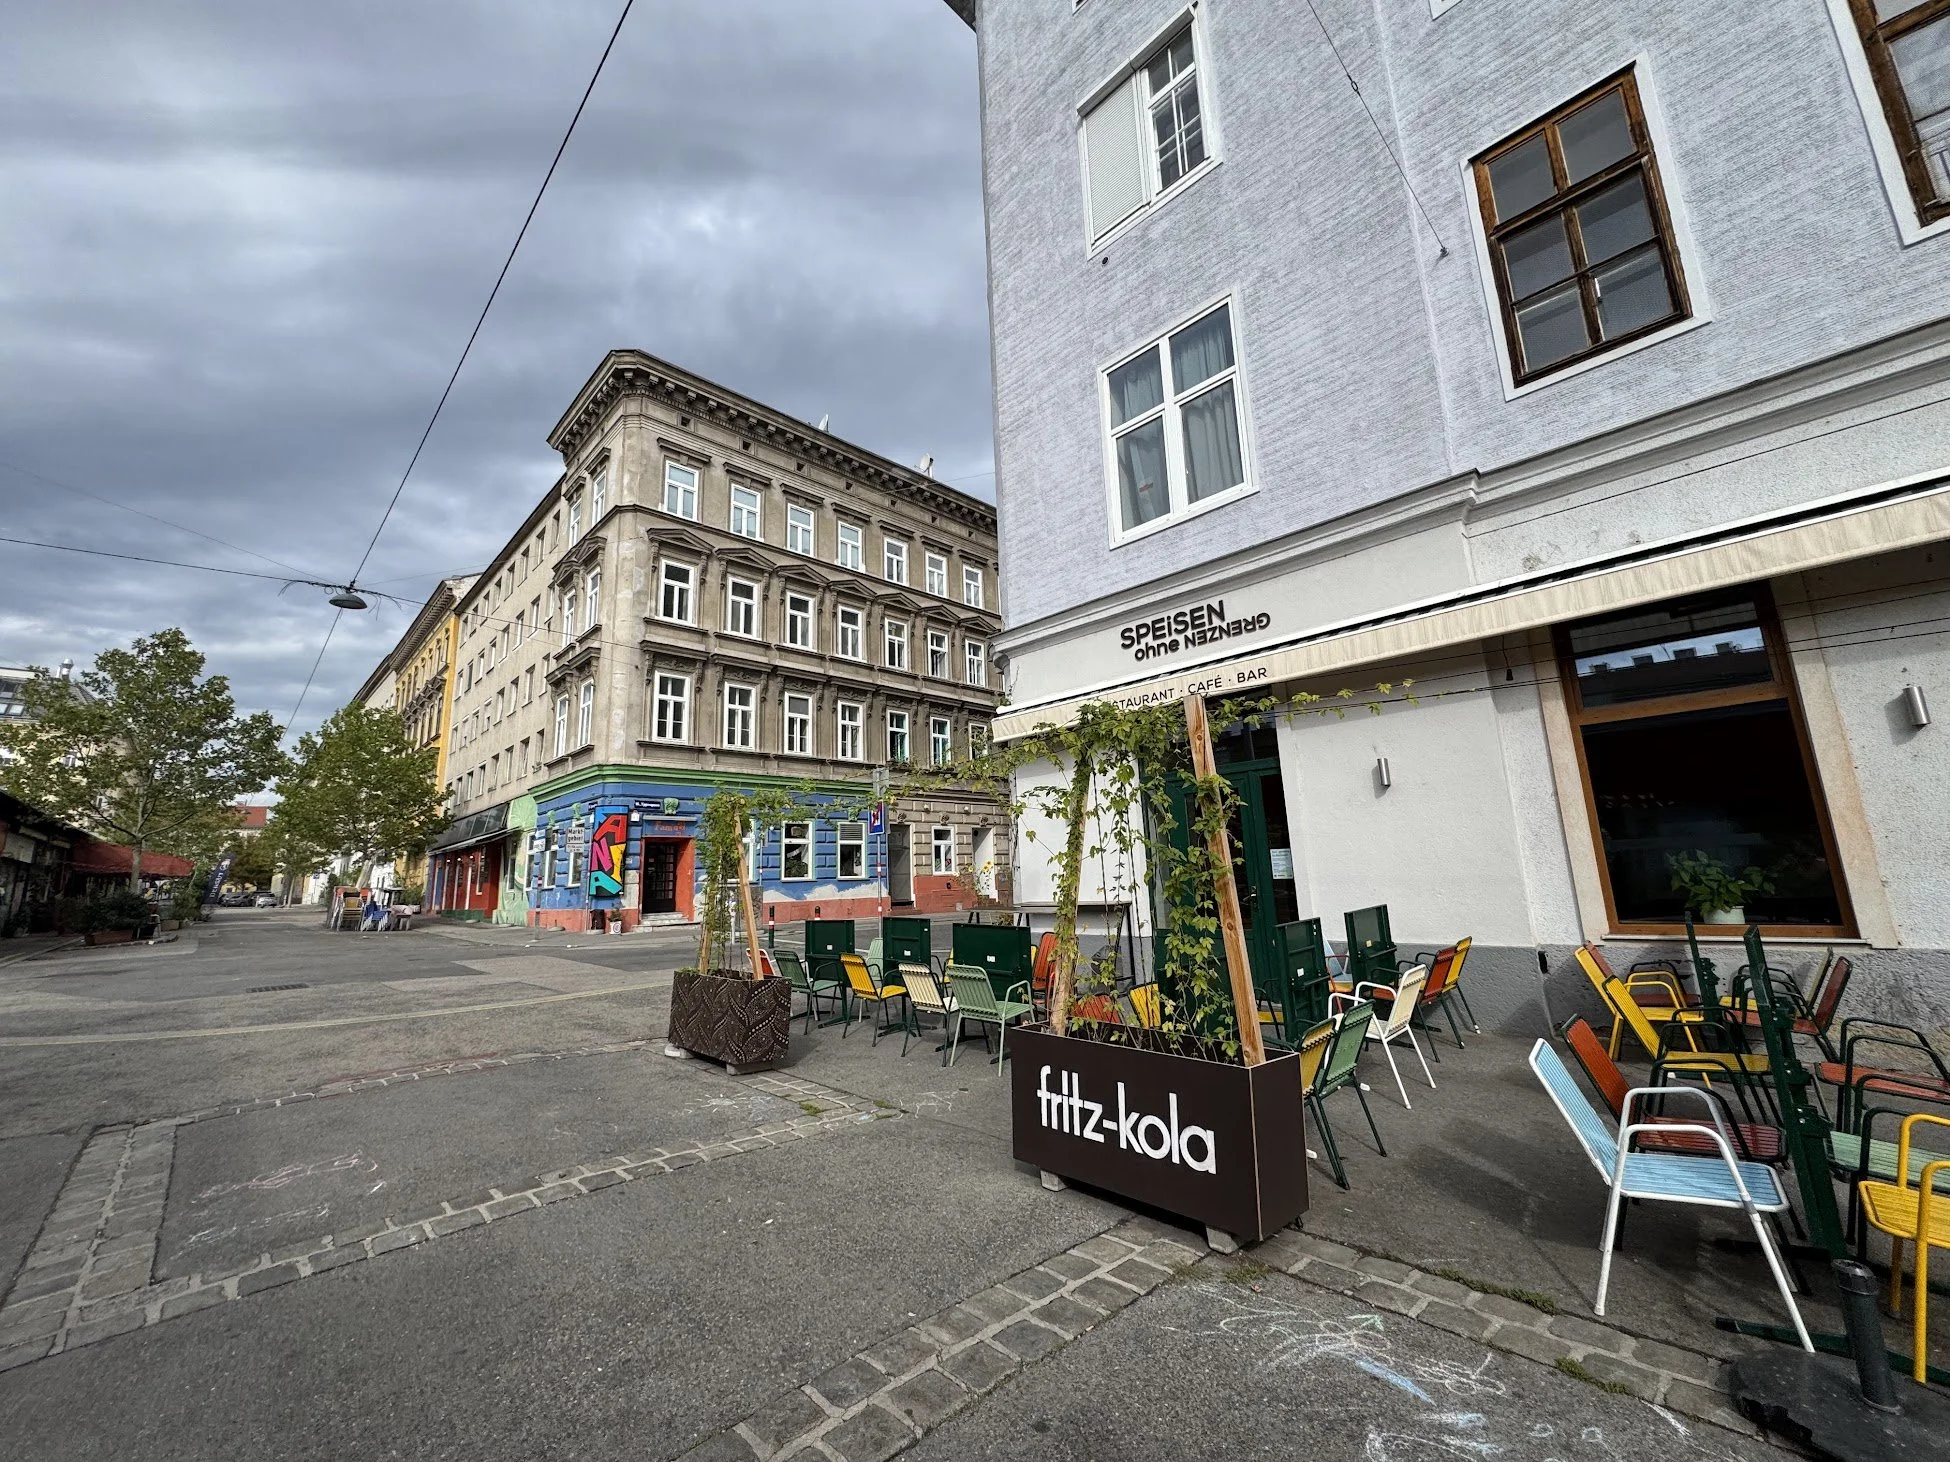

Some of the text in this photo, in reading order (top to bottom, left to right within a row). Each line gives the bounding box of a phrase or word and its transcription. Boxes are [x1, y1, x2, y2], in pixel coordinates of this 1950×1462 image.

[1134, 612, 1271, 662] ohne GRENZEN
[1112, 667, 1268, 710] STAURANT CAFÉ BAR
[1036, 1064, 1218, 1175] fritz-kola
